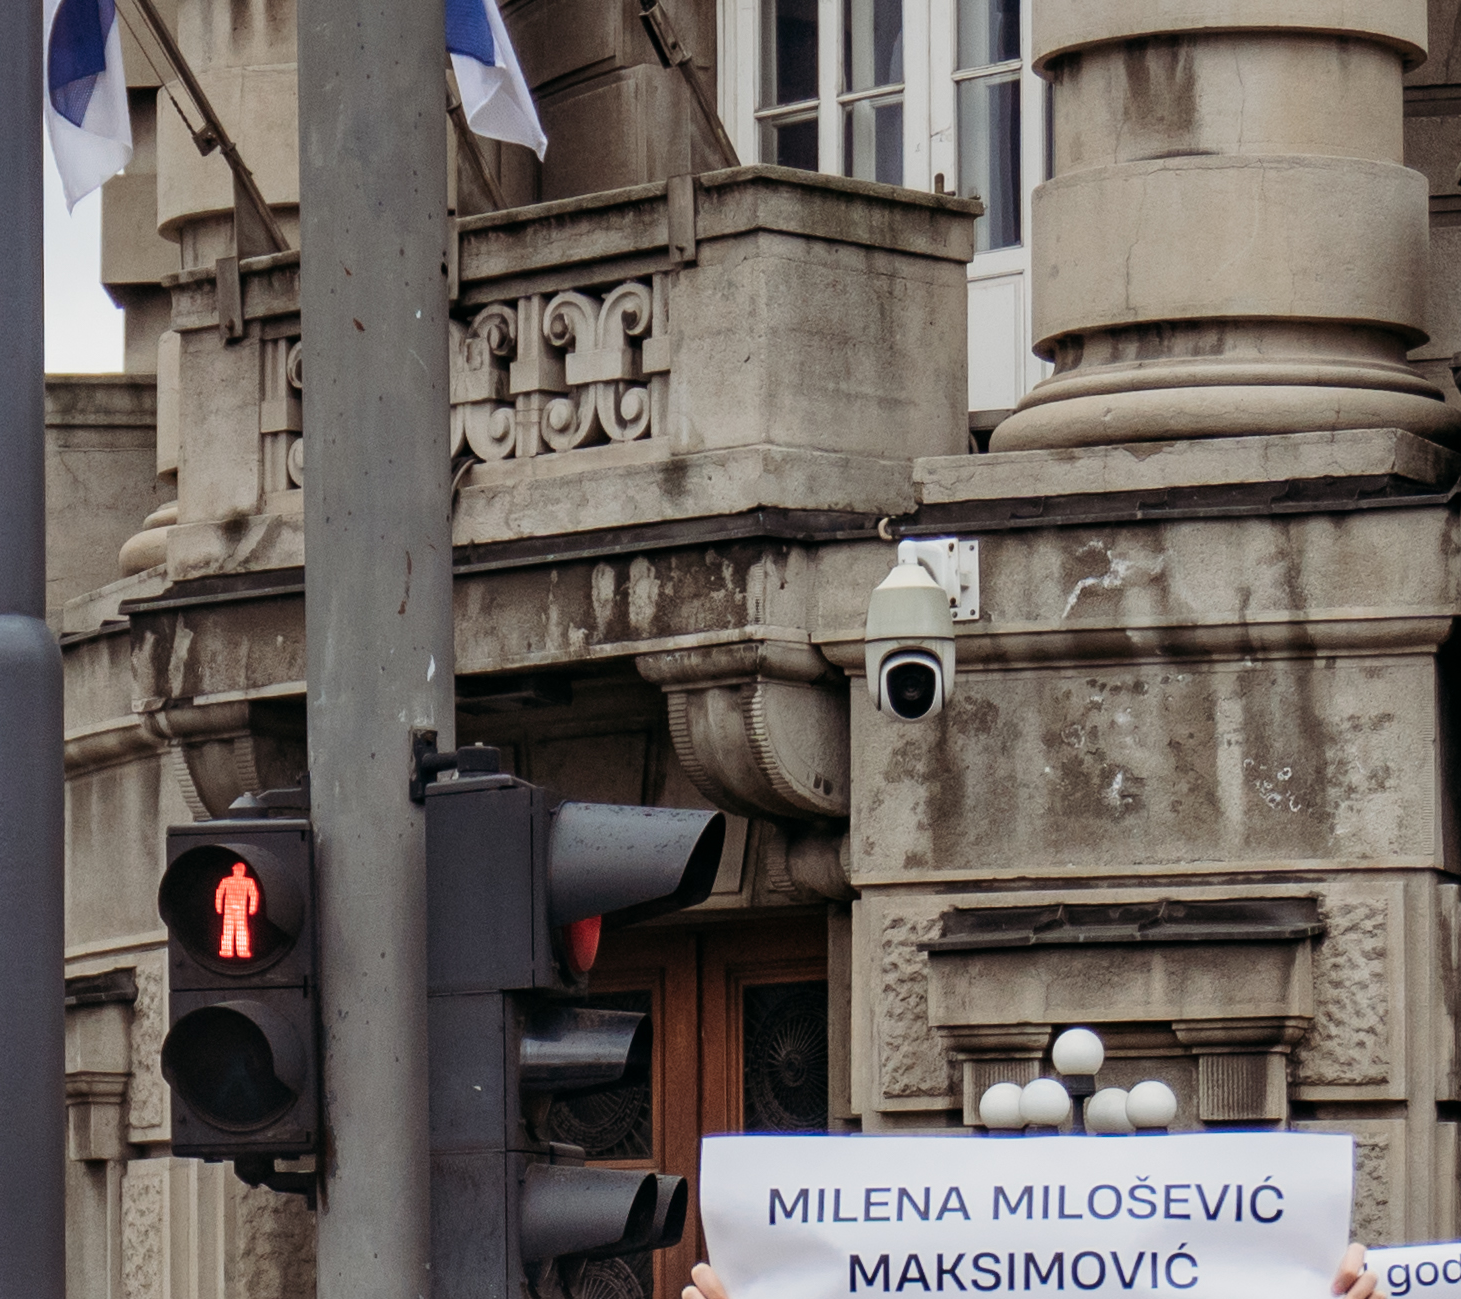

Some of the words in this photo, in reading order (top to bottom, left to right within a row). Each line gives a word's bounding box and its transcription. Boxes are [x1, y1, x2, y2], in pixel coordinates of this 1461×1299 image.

[769, 1187, 971, 1225] MILENA
[993, 1176, 1283, 1224] MILOŠEVIĆ
[850, 1243, 1197, 1292] MAKSIMOVIĆ
